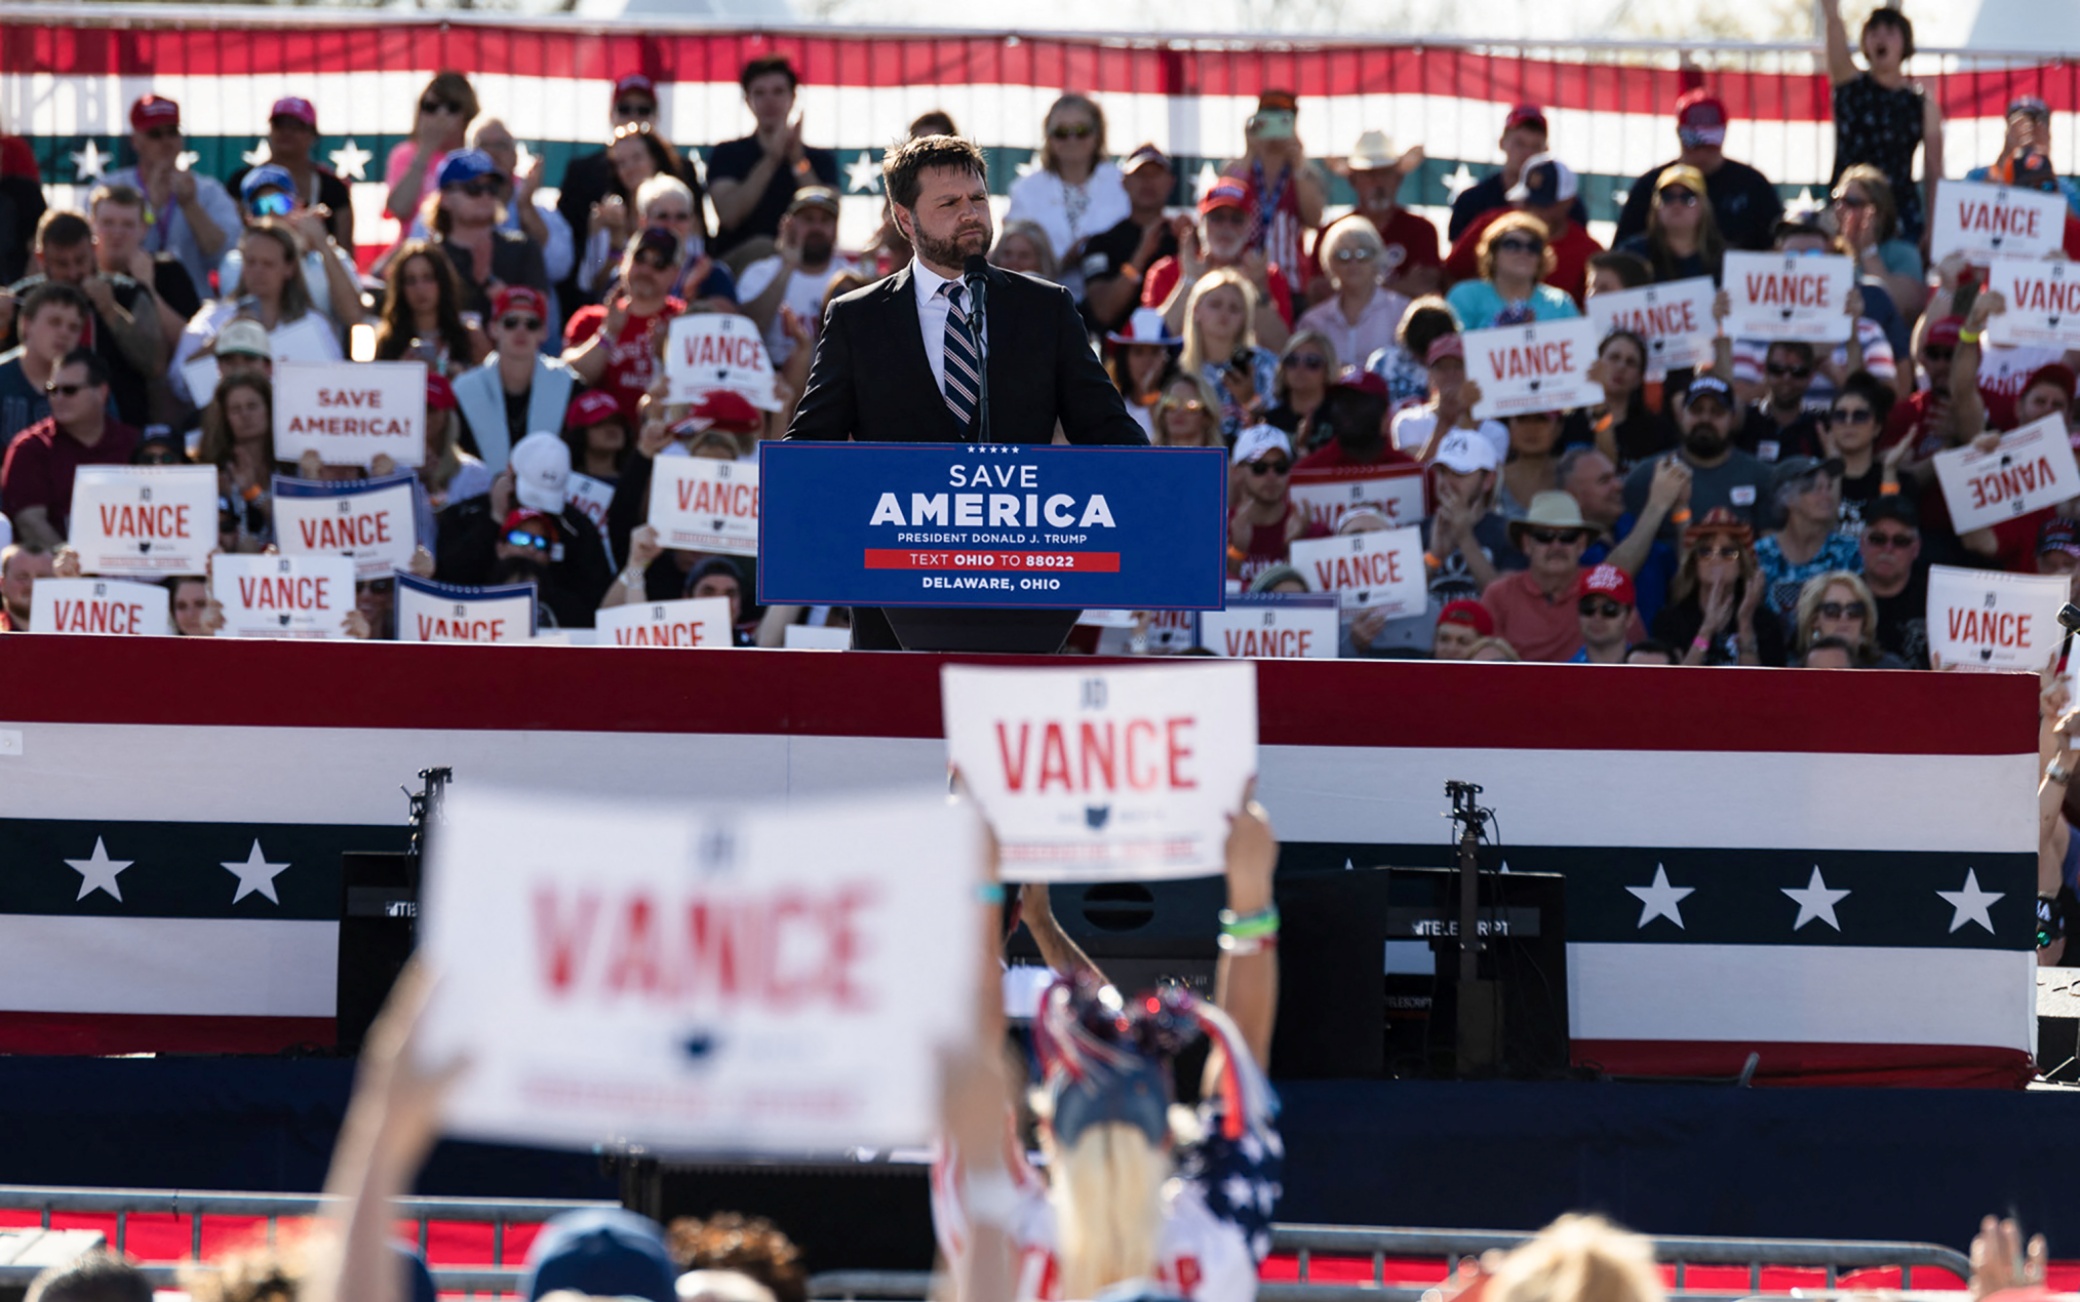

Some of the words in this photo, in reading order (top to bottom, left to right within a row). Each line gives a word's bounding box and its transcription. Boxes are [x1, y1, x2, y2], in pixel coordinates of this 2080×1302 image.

[1959, 199, 2041, 239] VANCE
[1746, 271, 1830, 308] VANCE
[2013, 275, 2080, 315] VANC
[684, 335, 764, 372] VANCE
[1488, 339, 1576, 382] VANCE
[317, 388, 382, 408] SAVE
[289, 416, 411, 438] AMERICA!
[949, 464, 1038, 488] SAVE
[1966, 455, 2057, 511] VANCE
[99, 503, 190, 538] VANCE
[869, 492, 1116, 528] AMERICA
[299, 509, 392, 550] VANCE
[898, 533, 968, 543] PRESIDENT
[972, 533, 1025, 543] DONALD
[1030, 534, 1040, 544] J.
[1044, 534, 1087, 544] TRUMP
[910, 553, 949, 565] TEXT
[954, 554, 995, 566] OHIO
[1000, 555, 1021, 567] TO
[1026, 555, 1074, 567] 88022
[1315, 549, 1403, 592] VANCE
[238, 576, 330, 610] VANCE
[922, 577, 1015, 591] DELAWARE,
[1020, 578, 1060, 590] OHIO
[53, 600, 143, 635] VANCE
[418, 613, 504, 642] VANCE
[615, 621, 705, 647] VANCE
[1948, 606, 2032, 648] VANCE
[1224, 628, 1313, 658] VANCE
[994, 716, 1198, 794] VANCE
[530, 876, 884, 1016] VANCE
